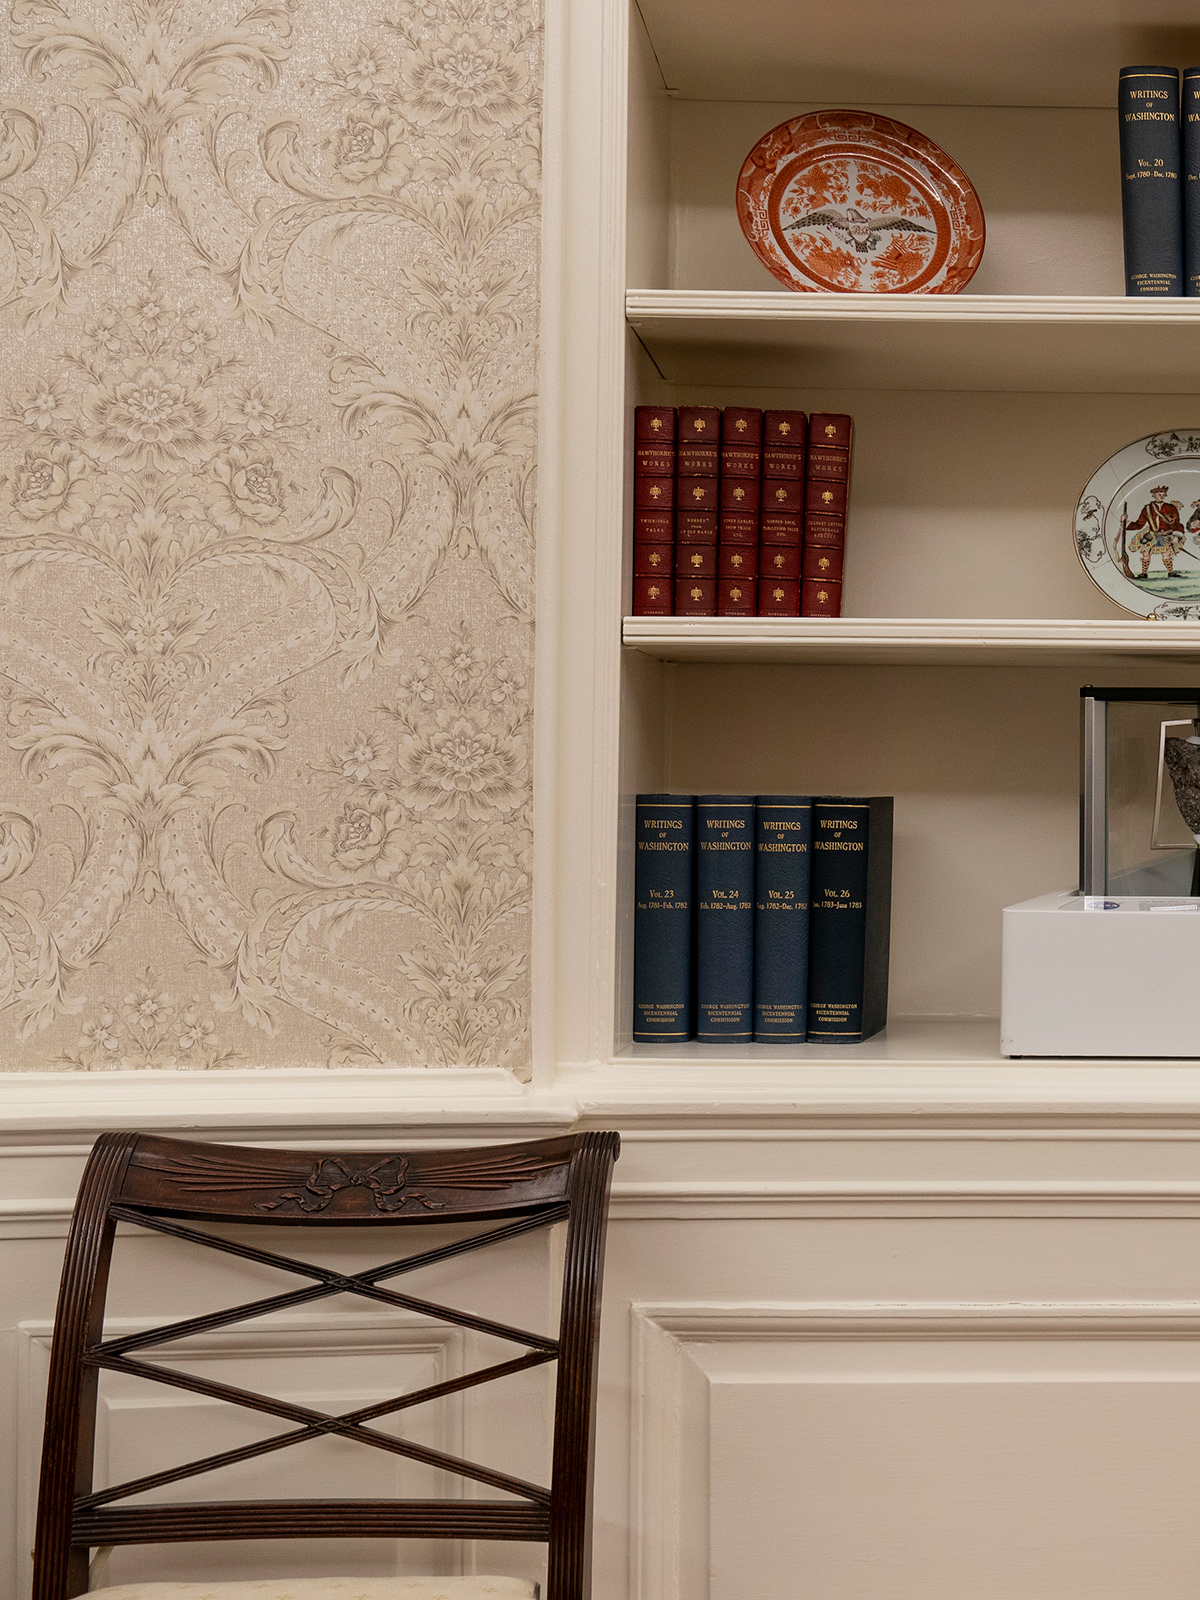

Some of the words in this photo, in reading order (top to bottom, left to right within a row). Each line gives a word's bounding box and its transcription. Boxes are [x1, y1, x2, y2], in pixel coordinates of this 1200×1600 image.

[1130, 90, 1169, 99] WRITINGS
[1125, 112, 1175, 122] WASHINGTON
[1154, 159, 1164, 167] 20
[644, 820, 683, 829] WRITINGS
[706, 820, 746, 829] WRITINGS
[763, 821, 801, 830] WRITINGS
[820, 820, 858, 829] WRITINGS
[638, 842, 689, 851] WASHINGTON
[700, 841, 752, 851] WASHINGTON
[758, 843, 807, 853] WASHINGTON
[814, 841, 864, 851] WASHINGTON
[664, 890, 674, 898] 23
[728, 890, 739, 898] 24
[784, 891, 794, 899] 25
[840, 889, 850, 898] 26
